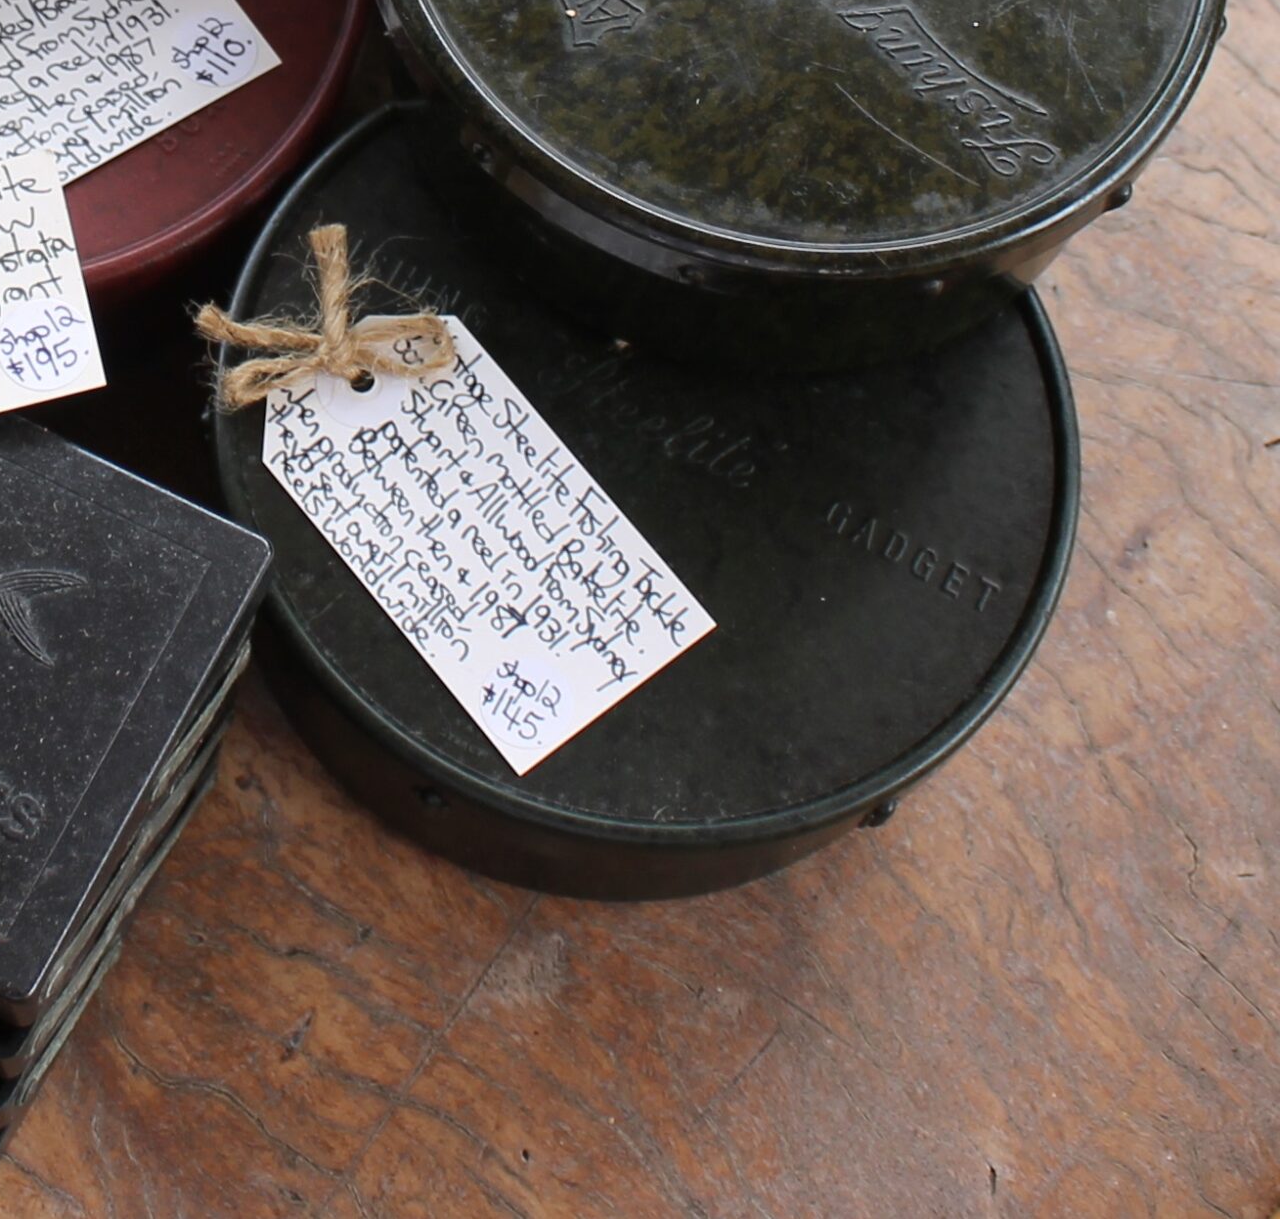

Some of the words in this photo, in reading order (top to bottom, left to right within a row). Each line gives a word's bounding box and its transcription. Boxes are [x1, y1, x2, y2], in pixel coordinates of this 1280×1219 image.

[15, 16, 86, 61] from
[27, 75, 49, 89] a
[46, 38, 96, 81] reel
[87, 27, 121, 54] in
[115, 0, 179, 40] 1931.
[27, 87, 89, 118] then
[96, 36, 156, 77] 1987
[171, 36, 210, 70] shop
[99, 74, 182, 129] million
[836, 1, 1061, 178] Fishing
[55, 112, 172, 182] orldwide.
[4, 338, 89, 382] $195.
[44, 305, 85, 333] 12
[302, 435, 404, 553] production
[347, 426, 436, 527] Between
[415, 513, 453, 572] then
[373, 419, 460, 510] patented
[447, 508, 462, 530] a
[460, 524, 509, 573] reel
[500, 569, 523, 601] in
[517, 593, 571, 657] 1931.
[400, 388, 470, 472] Stuart
[466, 482, 556, 573] Allwood
[538, 559, 580, 624] from
[569, 603, 638, 692] Sydney
[425, 379, 484, 459] Green
[485, 452, 571, 545] mottled
[551, 530, 644, 654] Bakelite.
[485, 397, 575, 507] Steelite
[568, 485, 645, 589] Fishing
[632, 557, 689, 647] Tackle
[269, 445, 331, 517] reels
[322, 505, 454, 658] worldwide.
[308, 466, 362, 523] sent
[346, 521, 397, 576] over
[397, 567, 472, 662] million
[825, 501, 1006, 614] GADGET
[482, 683, 545, 744] $145.
[496, 660, 537, 704] shop
[534, 679, 561, 717] 12
